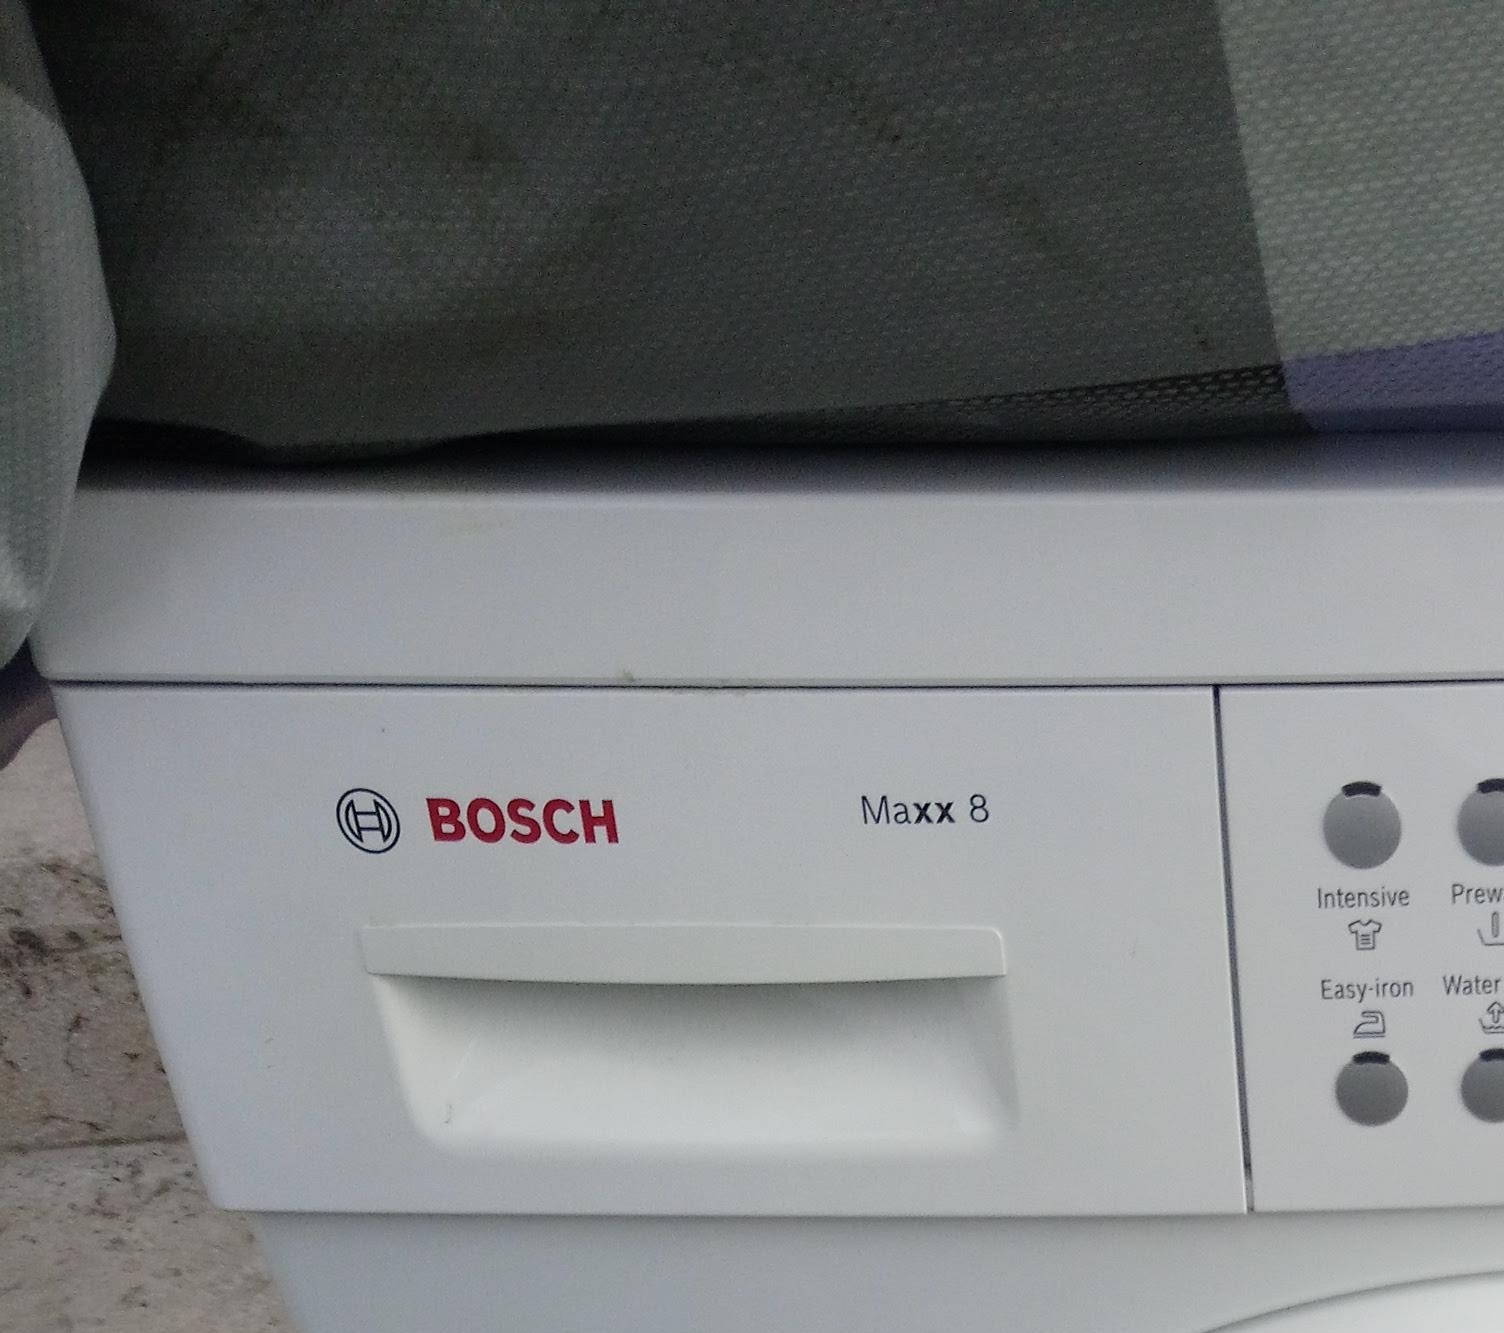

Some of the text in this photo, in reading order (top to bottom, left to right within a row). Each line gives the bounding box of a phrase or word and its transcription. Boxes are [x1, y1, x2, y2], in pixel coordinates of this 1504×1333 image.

[427, 798, 620, 845] BOSCH
[861, 794, 990, 826] Maxx 8
[1317, 887, 1410, 908] Intensive
[1321, 979, 1414, 1002] Easy-iron
[1443, 974, 1500, 996] Water
